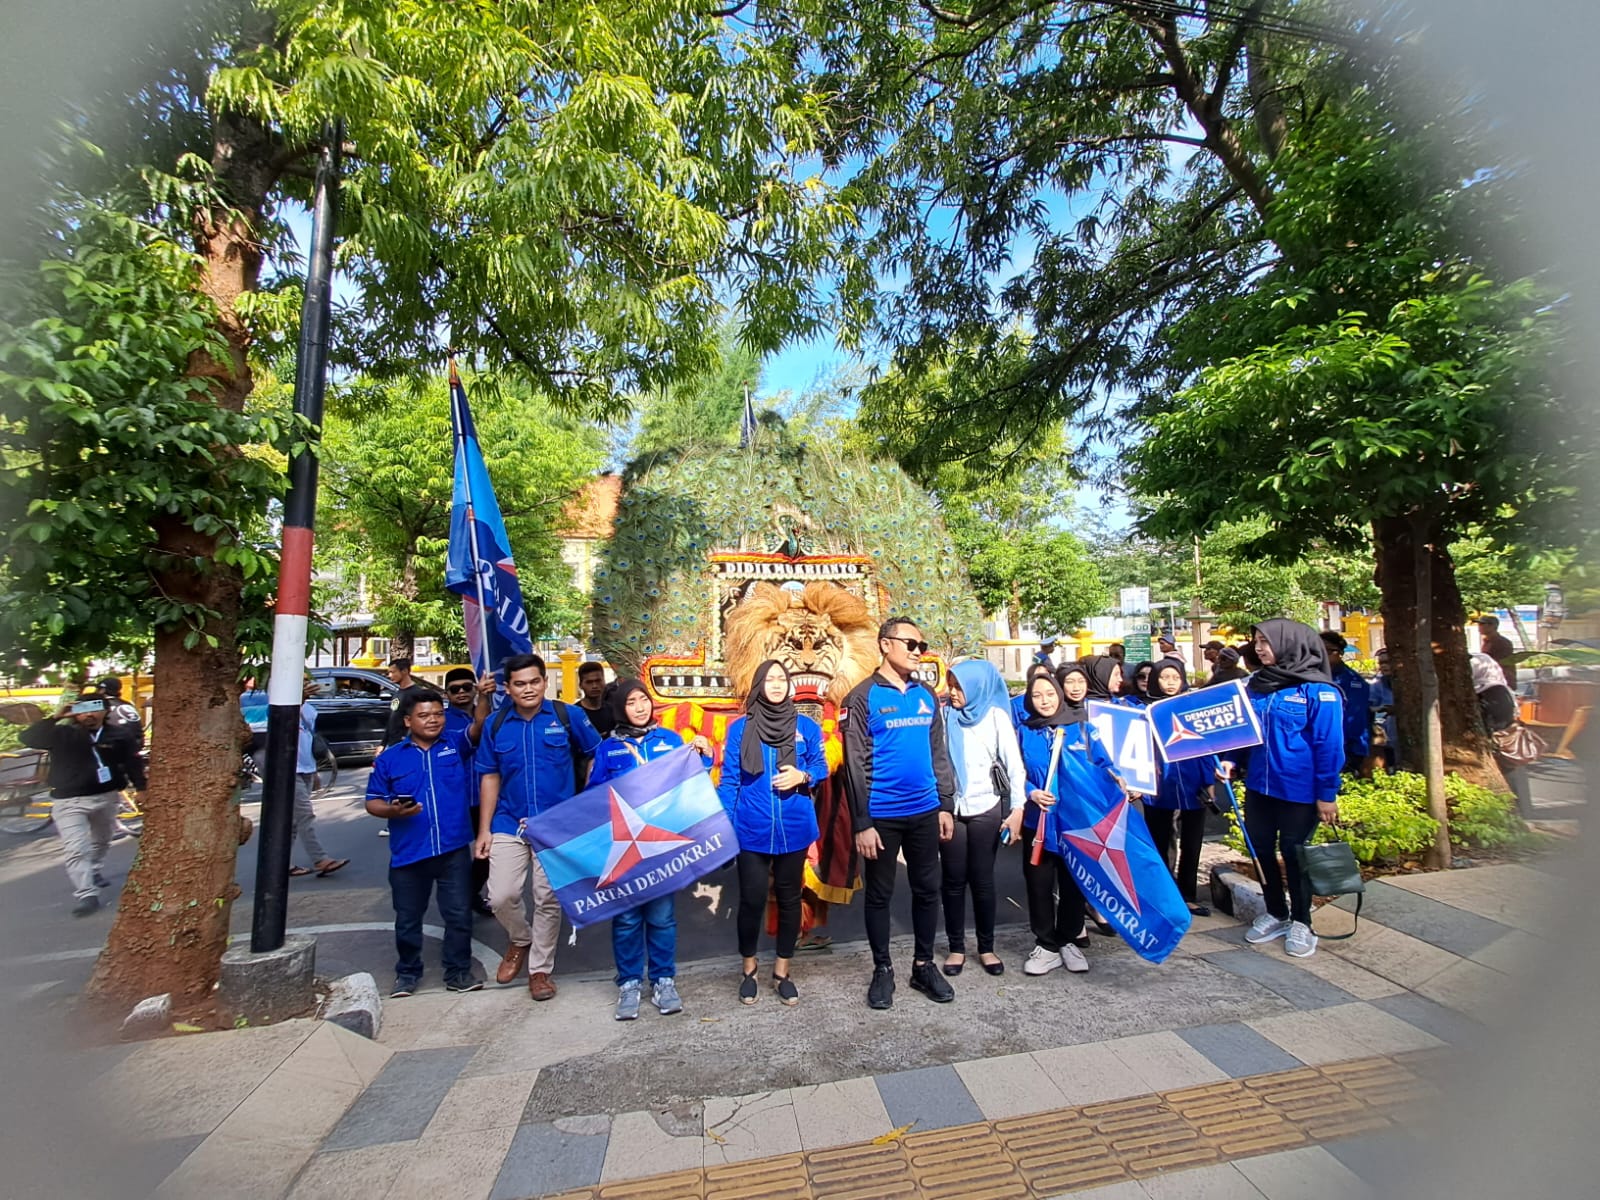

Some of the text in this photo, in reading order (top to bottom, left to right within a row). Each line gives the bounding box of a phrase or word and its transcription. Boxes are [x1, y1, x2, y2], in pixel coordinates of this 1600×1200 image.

[726, 562, 857, 575] DIDIK MUKRIANTO
[910, 670, 935, 681] ORO
[1184, 703, 1234, 722] DEMOKRAT
[1089, 712, 1154, 784] 14
[573, 832, 725, 915] PARTAI DEMOKRAT
[1076, 864, 1159, 950] DEMOKRAT
